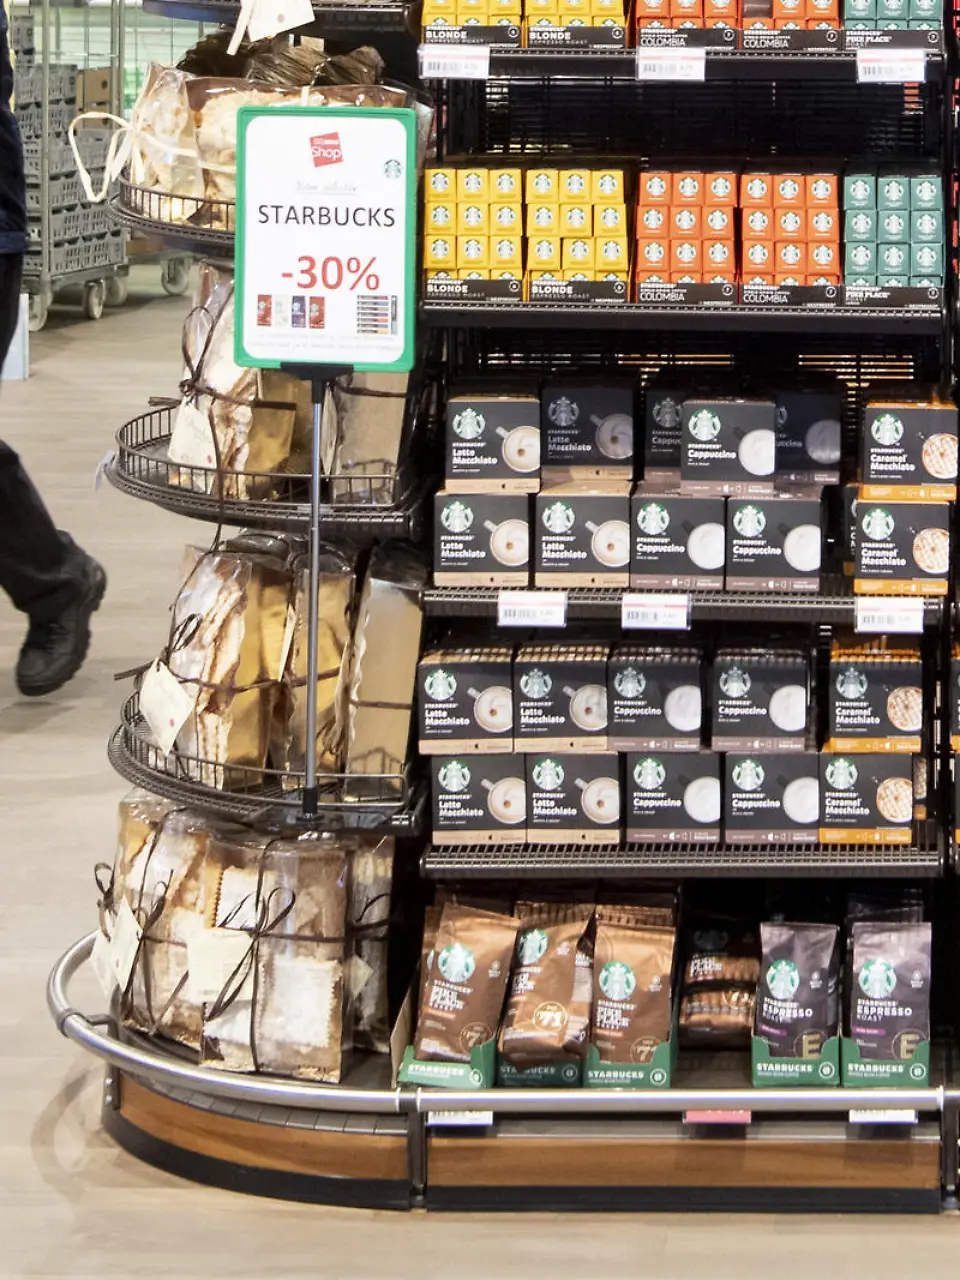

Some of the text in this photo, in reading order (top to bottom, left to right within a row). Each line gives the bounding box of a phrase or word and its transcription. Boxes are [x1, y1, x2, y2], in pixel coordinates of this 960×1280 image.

[426, 31, 468, 39] BLONDE
[529, 31, 571, 40] BLONDE
[641, 37, 686, 47] COLOMBIA
[743, 39, 789, 48] COLOMBIA
[311, 145, 342, 161] Shop
[257, 204, 396, 228] STARBUCKS
[281, 255, 380, 291] -30%
[427, 285, 469, 293] BLONDE
[532, 286, 573, 294] BLONDE
[640, 293, 685, 302] COLOMBIA
[743, 294, 788, 303] COLOMBIA
[687, 450, 737, 460] Cappuccino
[870, 454, 907, 462] Caramel
[452, 457, 498, 465] Macchiato
[870, 463, 916, 471] Macchiato
[441, 542, 464, 550] Latte
[541, 542, 565, 550] Latte
[637, 544, 686, 554] Cappuccino
[733, 545, 782, 555] Cappuccino
[441, 550, 486, 558] Macchiato
[541, 550, 587, 559] Macchiato
[861, 549, 898, 558] Caramel
[861, 557, 906, 566] Macchiato
[425, 709, 447, 717] Latte
[520, 708, 543, 716] Latte
[614, 706, 662, 716] Cappuccino
[718, 706, 767, 716] Cappuccino
[835, 707, 873, 716] Caramel
[425, 717, 470, 726] Macchiato
[520, 716, 566, 724] Macchiato
[835, 716, 881, 725] Macchiato
[439, 801, 461, 809] Latte
[533, 799, 555, 807] Latte
[633, 798, 682, 808] Cappuccino
[732, 799, 781, 809] Cappuccino
[825, 798, 861, 807] Caramel
[439, 809, 484, 817] Macchiato
[533, 807, 577, 816] Macchiato
[825, 807, 870, 815] Macchiato
[762, 1004, 813, 1018] ESPRESSO
[857, 1005, 913, 1016] ESPRESSO
[407, 1063, 465, 1076] STARBUCKS
[756, 1062, 813, 1073] STARBUCKS
[847, 1062, 904, 1073] STARBUCKS
[588, 1070, 644, 1079] STARBUCKS
